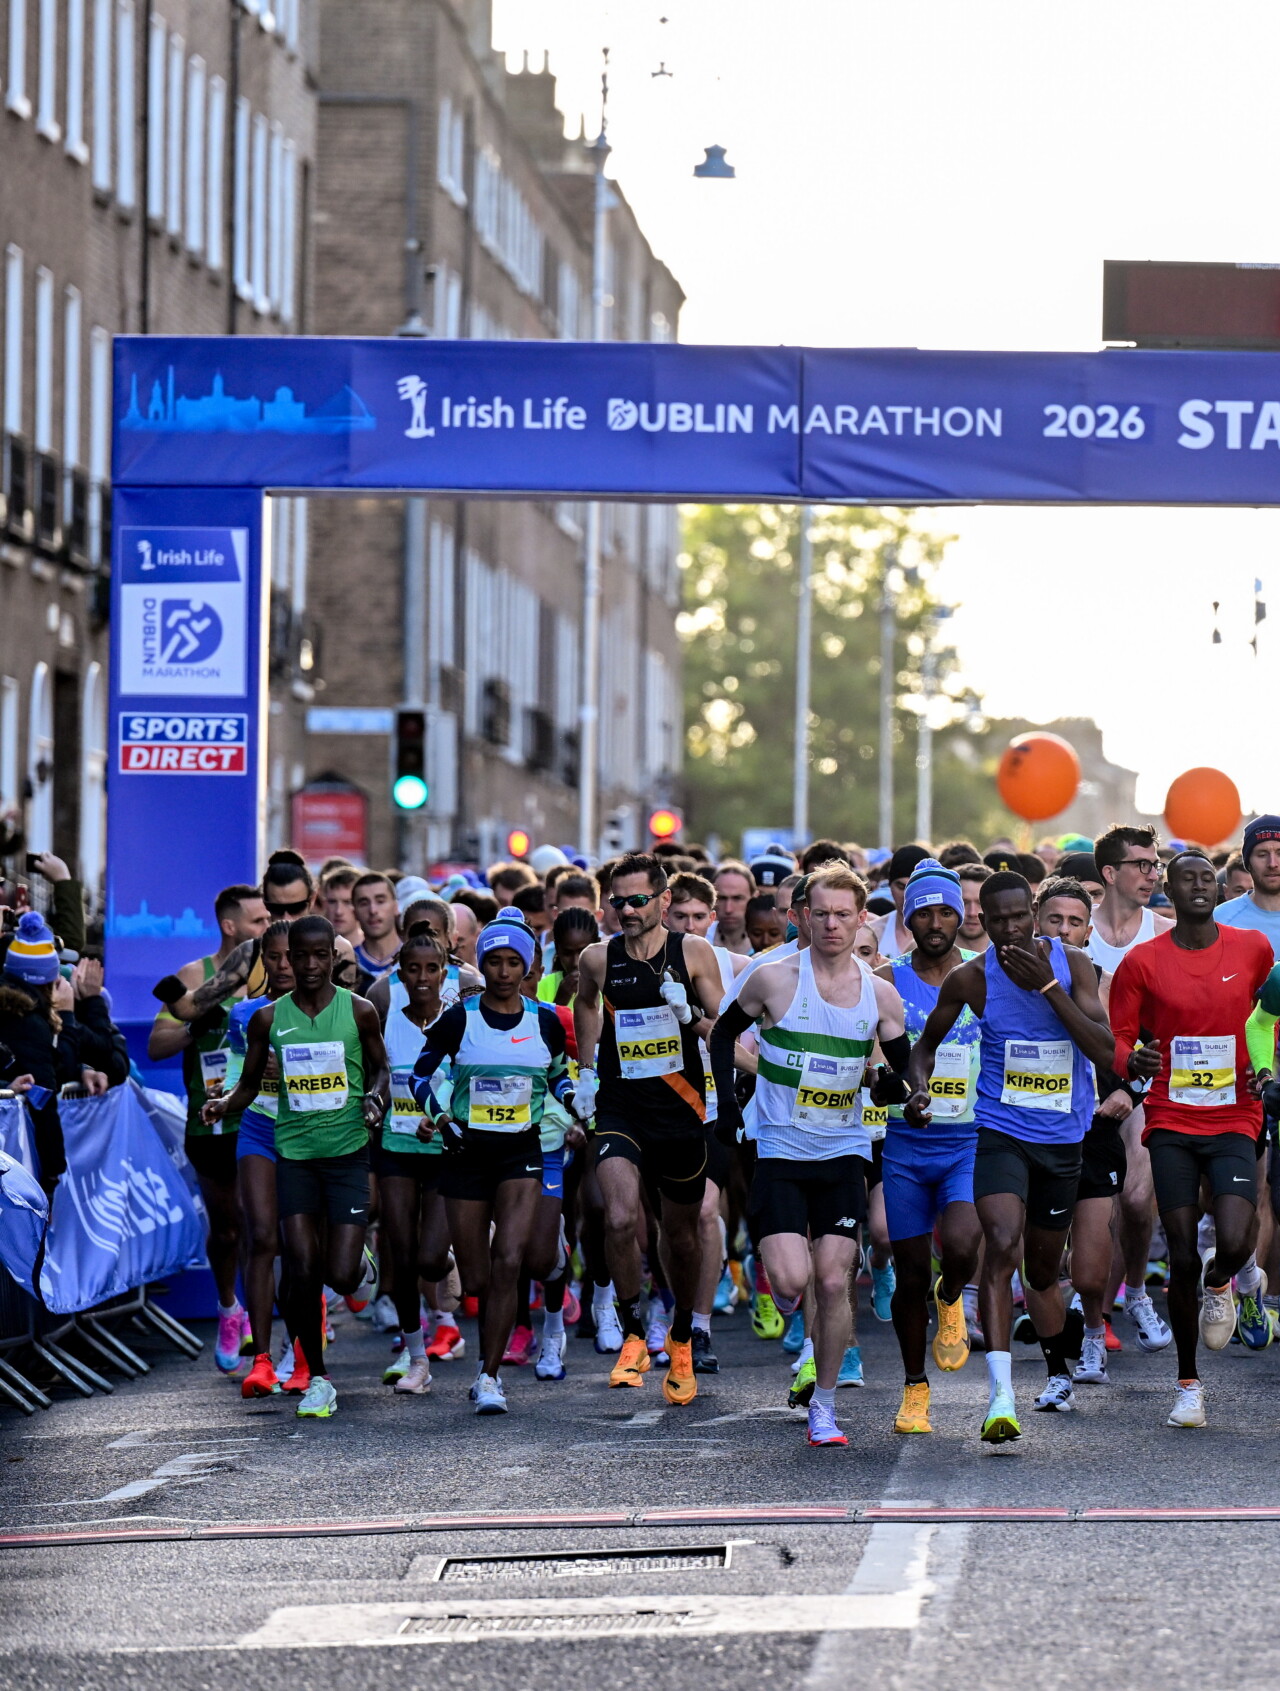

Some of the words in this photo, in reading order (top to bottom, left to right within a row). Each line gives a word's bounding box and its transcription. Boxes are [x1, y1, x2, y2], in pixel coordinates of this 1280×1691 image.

[441, 397, 515, 430] Irish
[524, 398, 586, 431] Life
[767, 405, 1002, 439] MARATHON
[1044, 404, 1145, 440] 2026
[158, 550, 190, 565] Irish
[194, 550, 224, 566] Life
[143, 598, 156, 665] DUBLIN
[143, 668, 220, 678] MARATHON
[128, 718, 239, 741] SPORTS
[127, 748, 237, 769] DIRECT
[620, 1039, 679, 1058] PACER
[288, 1076, 345, 1091] AREBA
[1006, 1073, 1069, 1091] KIPROP
[1191, 1072, 1214, 1087] 32
[800, 1088, 855, 1107] TOBIN
[393, 1101, 424, 1113] WUB
[486, 1108, 516, 1122] 152
